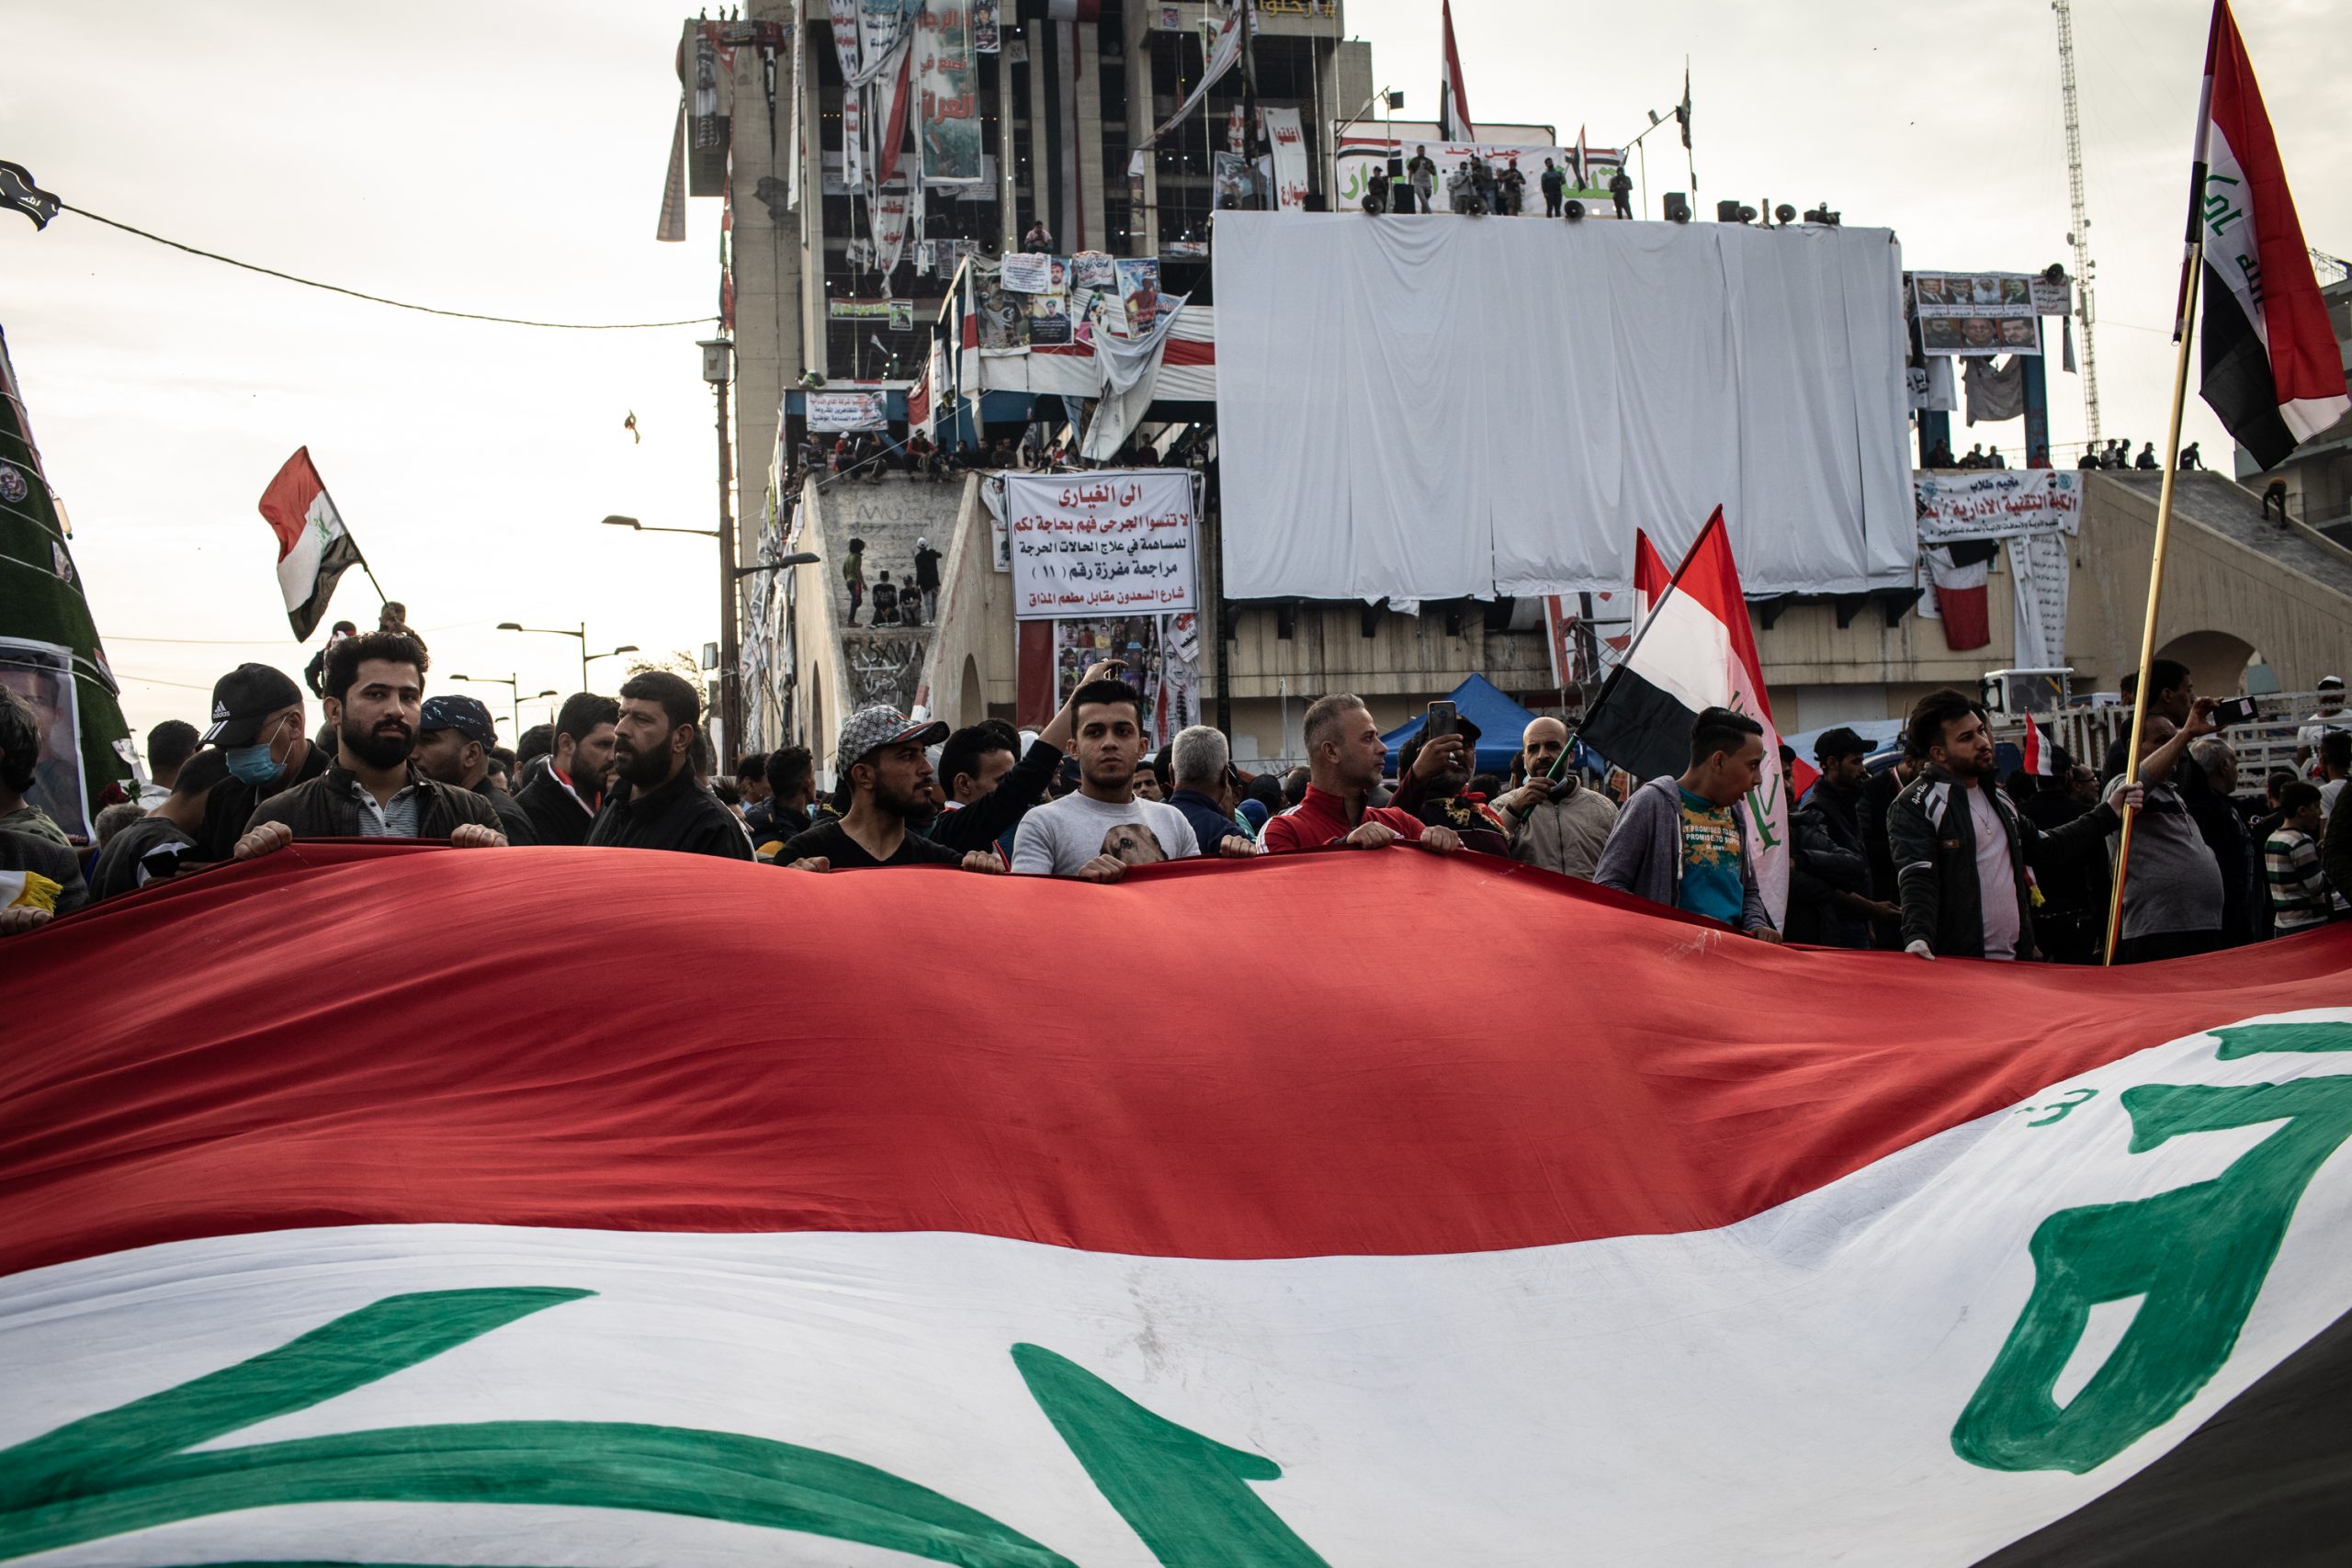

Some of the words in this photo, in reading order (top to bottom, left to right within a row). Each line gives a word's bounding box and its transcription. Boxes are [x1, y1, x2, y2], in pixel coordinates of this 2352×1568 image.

[1058, 484, 1115, 509] الغيارى
[1119, 484, 1142, 507] الى
[1013, 516, 1034, 536] لكم
[1037, 516, 1073, 535] بحاجة
[1077, 515, 1097, 534] فهم
[1100, 515, 1142, 534] الجرحى
[1146, 514, 1177, 533] تنسوا
[1181, 513, 1190, 525] لا
[1020, 542, 1057, 557] الحرجة
[1059, 540, 1098, 553] الحالات
[1101, 541, 1125, 554] علاج
[1126, 539, 1138, 553] في
[1141, 537, 1186, 550] للمساهمة
[1069, 564, 1092, 581] رقم
[1095, 561, 1130, 580] مفرزة
[1132, 560, 1178, 580] مراجعة
[1028, 592, 1056, 607] المذاق
[1058, 592, 1084, 605] مطعم
[1087, 590, 1114, 605] مقابل
[1117, 589, 1159, 604] السعدون
[1160, 587, 1184, 603] شارع
[212, 710, 231, 719] adidas
